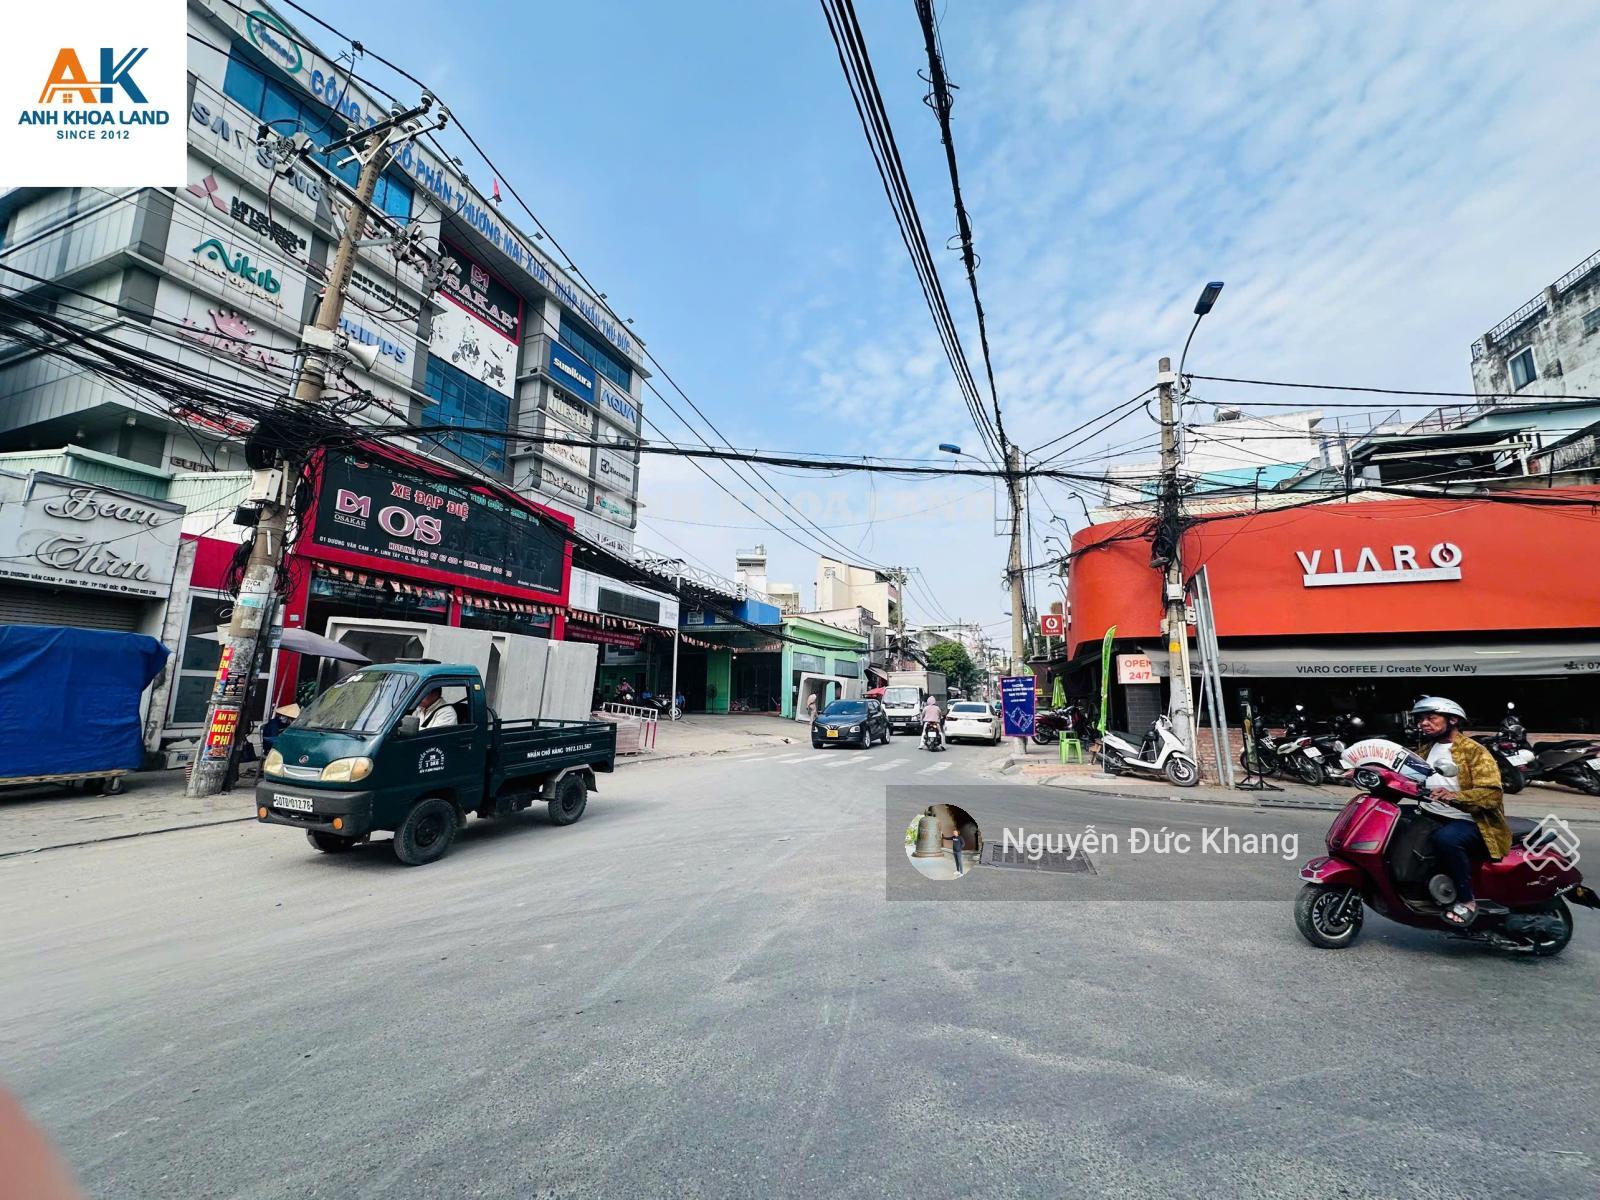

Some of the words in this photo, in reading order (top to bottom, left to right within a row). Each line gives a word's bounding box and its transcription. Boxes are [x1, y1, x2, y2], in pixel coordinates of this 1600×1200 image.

[191, 101, 322, 201] SASNG
[601, 388, 636, 424] AQUA
[390, 481, 412, 501] XE
[414, 489, 444, 511] ĐẠP
[378, 505, 442, 545] OS
[1295, 542, 1463, 576] VIARO
[1129, 671, 1151, 680] 24/7
[1296, 665, 1330, 674] VIARO
[1332, 665, 1377, 674] COFFEE
[1386, 664, 1422, 674] Create
[1424, 664, 1450, 673] Your
[1453, 663, 1478, 674] Way
